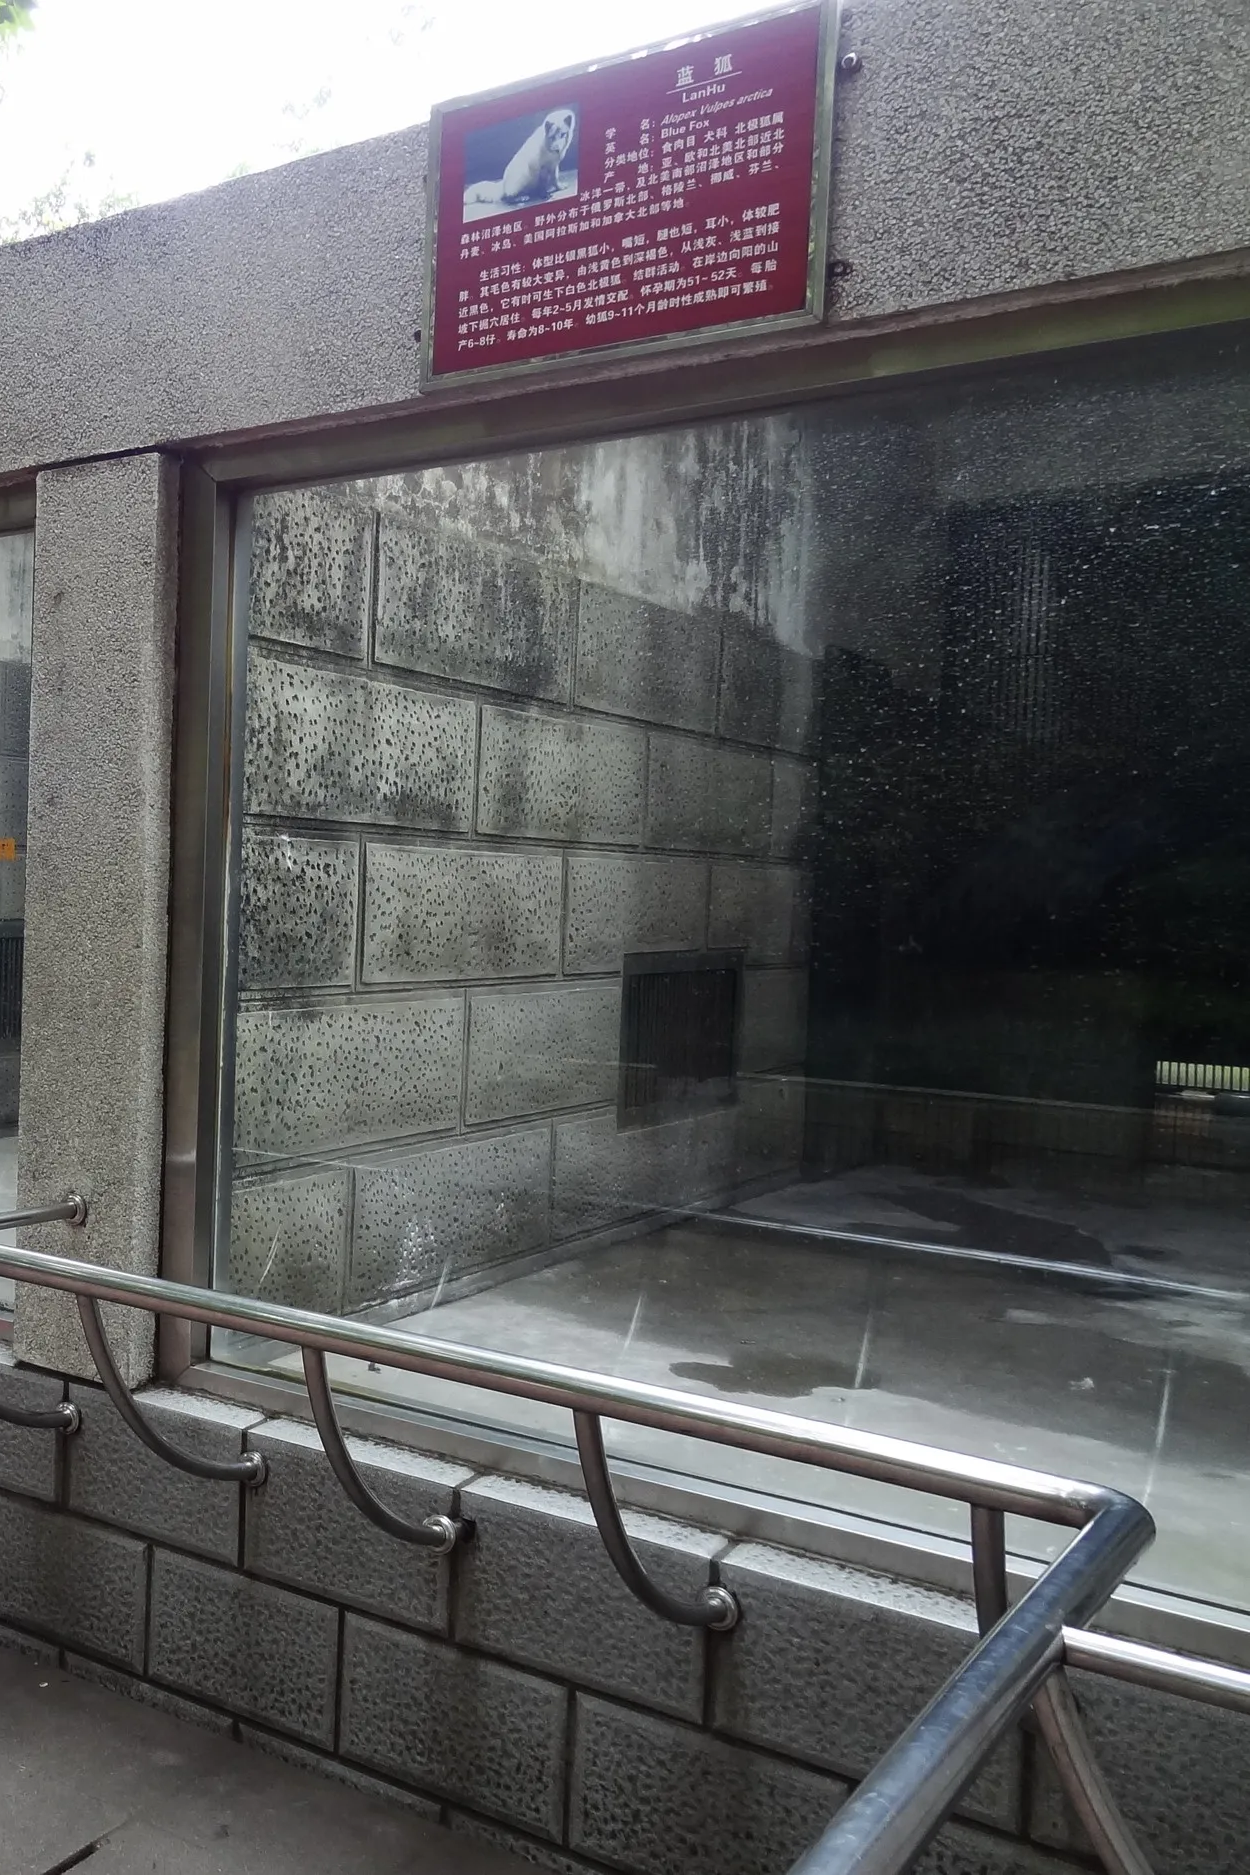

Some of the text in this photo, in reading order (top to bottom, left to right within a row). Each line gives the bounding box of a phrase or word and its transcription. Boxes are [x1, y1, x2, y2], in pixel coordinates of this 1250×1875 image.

[681, 82, 726, 104] LanHu
[660, 108, 696, 127] Alopex
[698, 97, 736, 117] Vulpes
[736, 87, 773, 106] arctica
[660, 123, 687, 140] Blue
[689, 117, 710, 133] Fox
